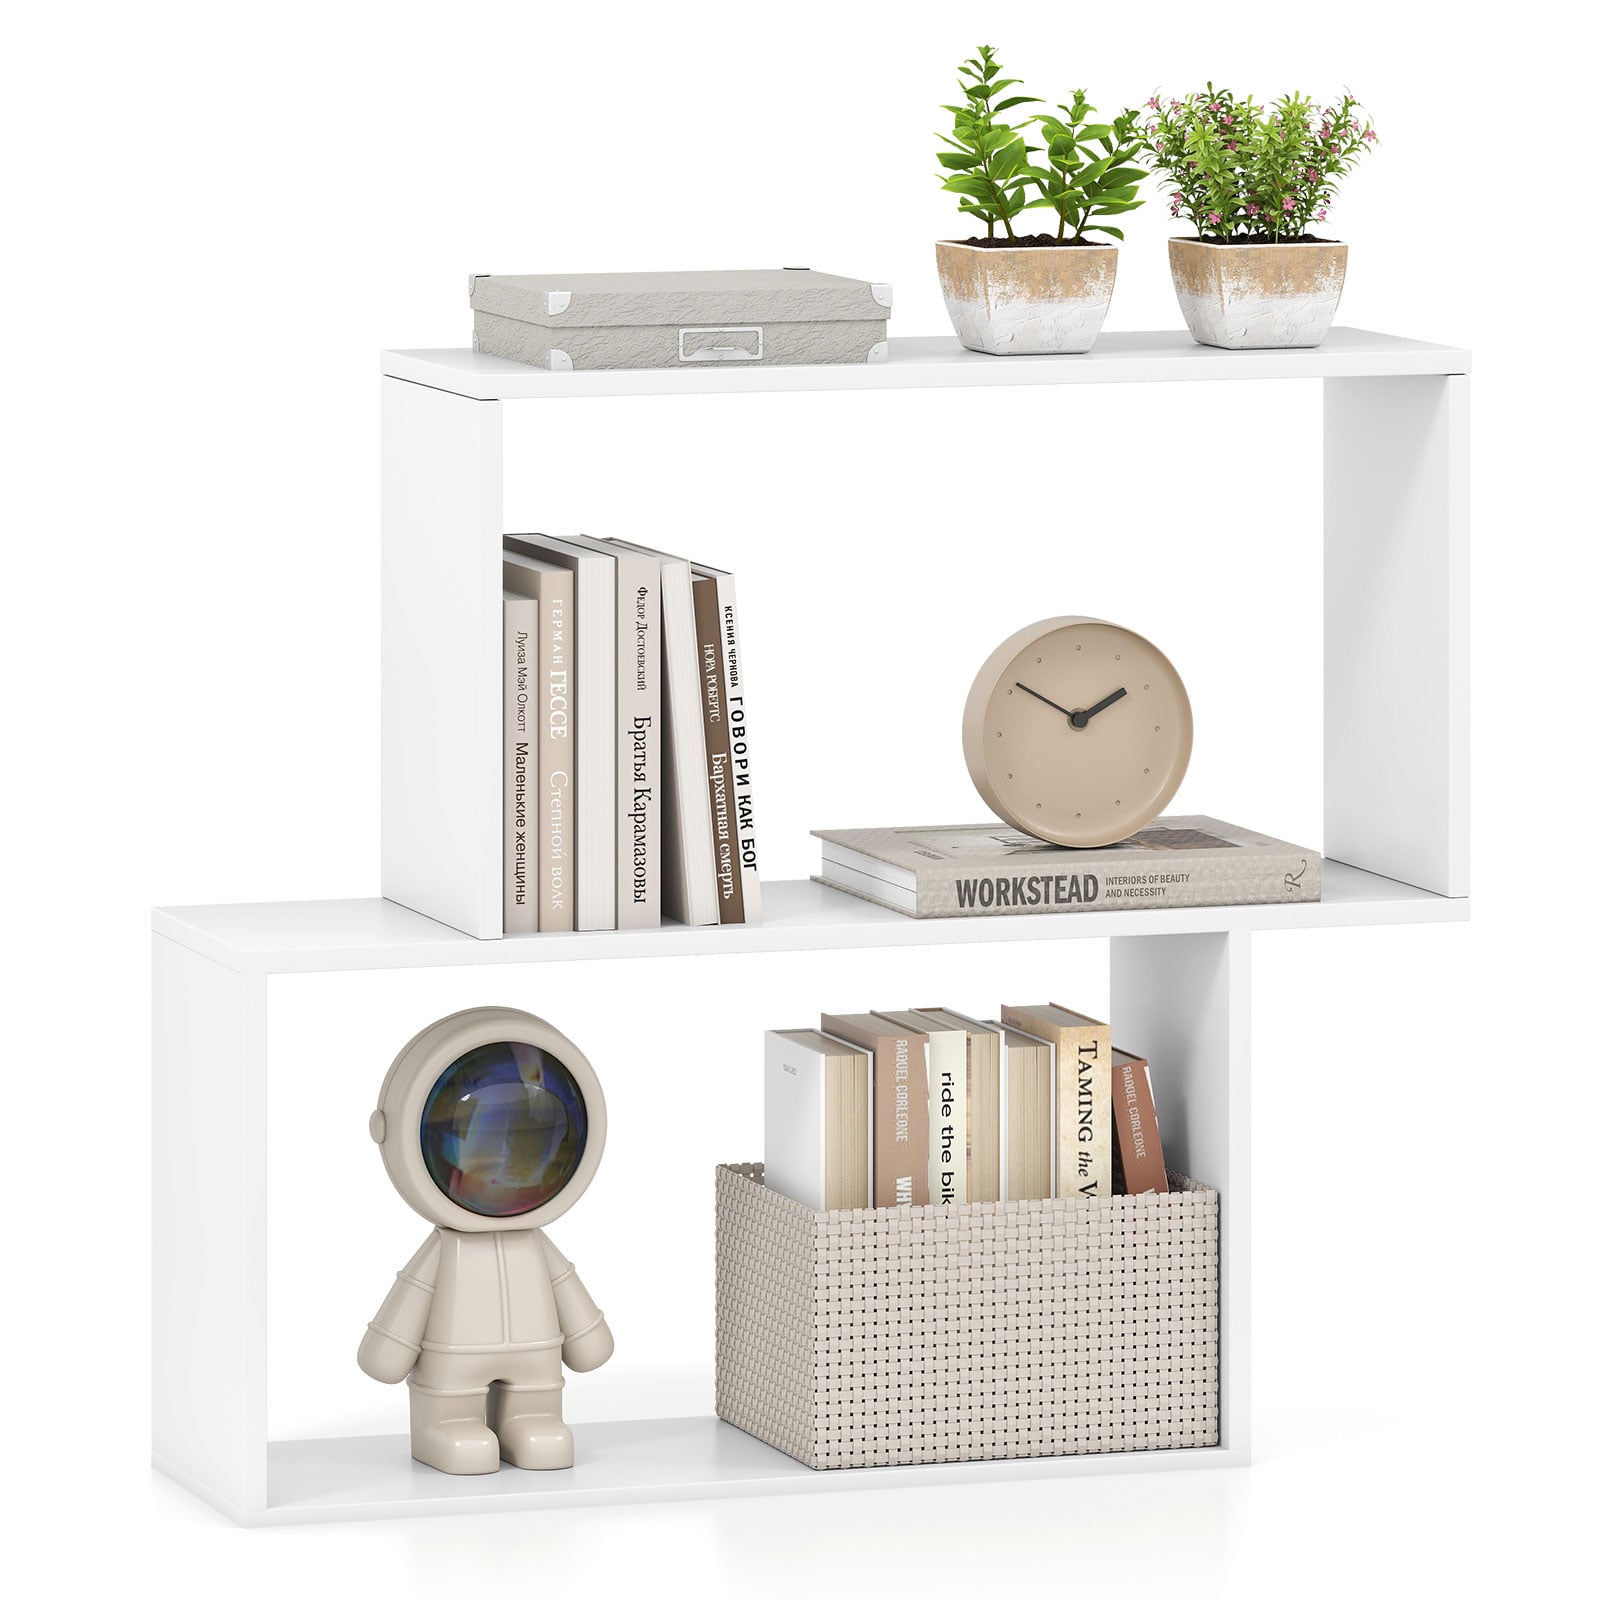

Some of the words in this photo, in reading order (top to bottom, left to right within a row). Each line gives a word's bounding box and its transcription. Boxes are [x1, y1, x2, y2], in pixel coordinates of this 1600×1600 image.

[515, 630, 528, 664] Луиза
[552, 599, 563, 664] ГЕРМАН
[724, 605, 736, 646] КСЕНИЯ
[517, 667, 528, 691] Мэй
[703, 643, 717, 673] НОРА
[727, 648, 739, 688] ЧЕРНОВА
[517, 693, 528, 732] Олкотт
[550, 669, 568, 739] ГЕССЕ
[706, 674, 721, 723] РОБЕРТС
[628, 715, 651, 782] Братья
[729, 696, 751, 786] ГОВОРИ
[515, 742, 529, 828] Маленькие
[710, 752, 730, 840] Бархатная
[550, 770, 568, 859] Степной
[737, 795, 754, 830] КАК
[628, 787, 652, 904] Карамазовы
[741, 838, 757, 872] БОГ
[514, 831, 526, 905] женщины
[551, 866, 563, 910] волк
[718, 844, 734, 900] смерть
[1105, 875, 1147, 886] INTERIORS
[1149, 875, 1159, 885] OF
[1160, 873, 1190, 884] BEAUTY
[955, 874, 1099, 908] WORKSTEAD
[1105, 889, 1122, 898] AND
[1123, 887, 1167, 898] NECESSITY
[896, 1039, 908, 1082] RAQUEL
[941, 1072, 954, 1118] ride
[1078, 1040, 1098, 1142] TAMING
[1122, 1066, 1137, 1106] RAQUEL
[896, 1085, 908, 1142] CORLEONE
[1129, 1107, 1146, 1159] CORLEONE
[941, 1125, 954, 1164] the
[1078, 1152, 1093, 1177] the
